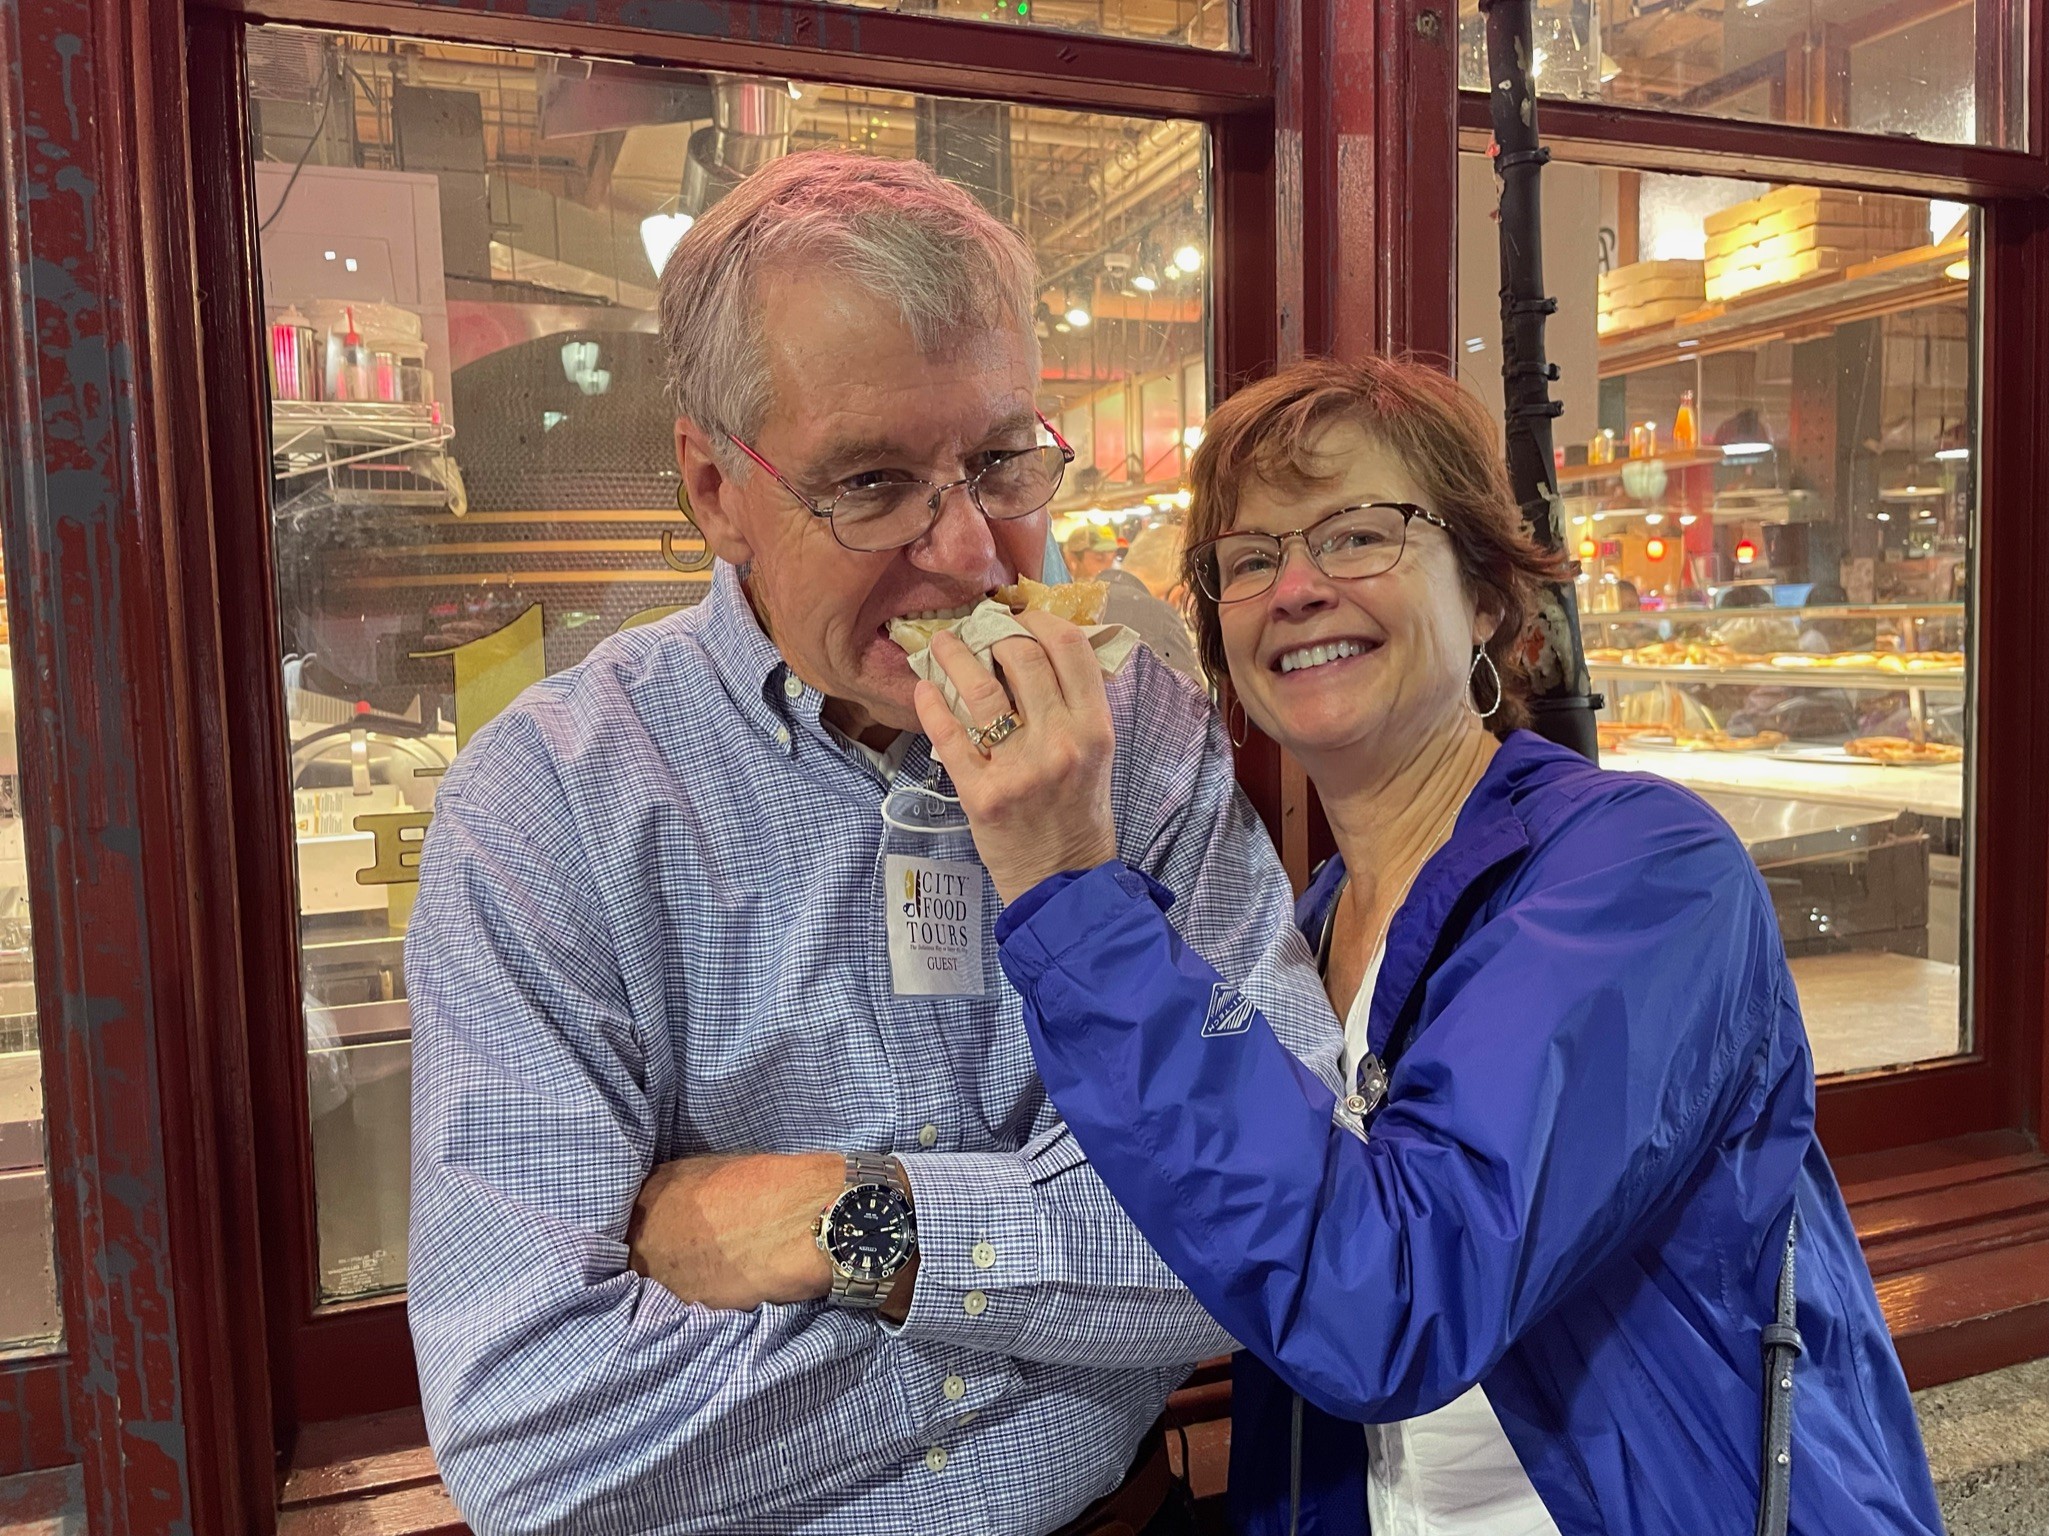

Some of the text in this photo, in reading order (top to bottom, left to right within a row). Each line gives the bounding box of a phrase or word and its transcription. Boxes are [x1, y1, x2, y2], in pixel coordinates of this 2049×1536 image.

[922, 871, 967, 896] CITY
[923, 897, 967, 922] FOOD
[906, 921, 968, 947] TOURS
[927, 956, 958, 971] GUEST
[840, 1260, 855, 1274] 50
[881, 1266, 896, 1278] 40
